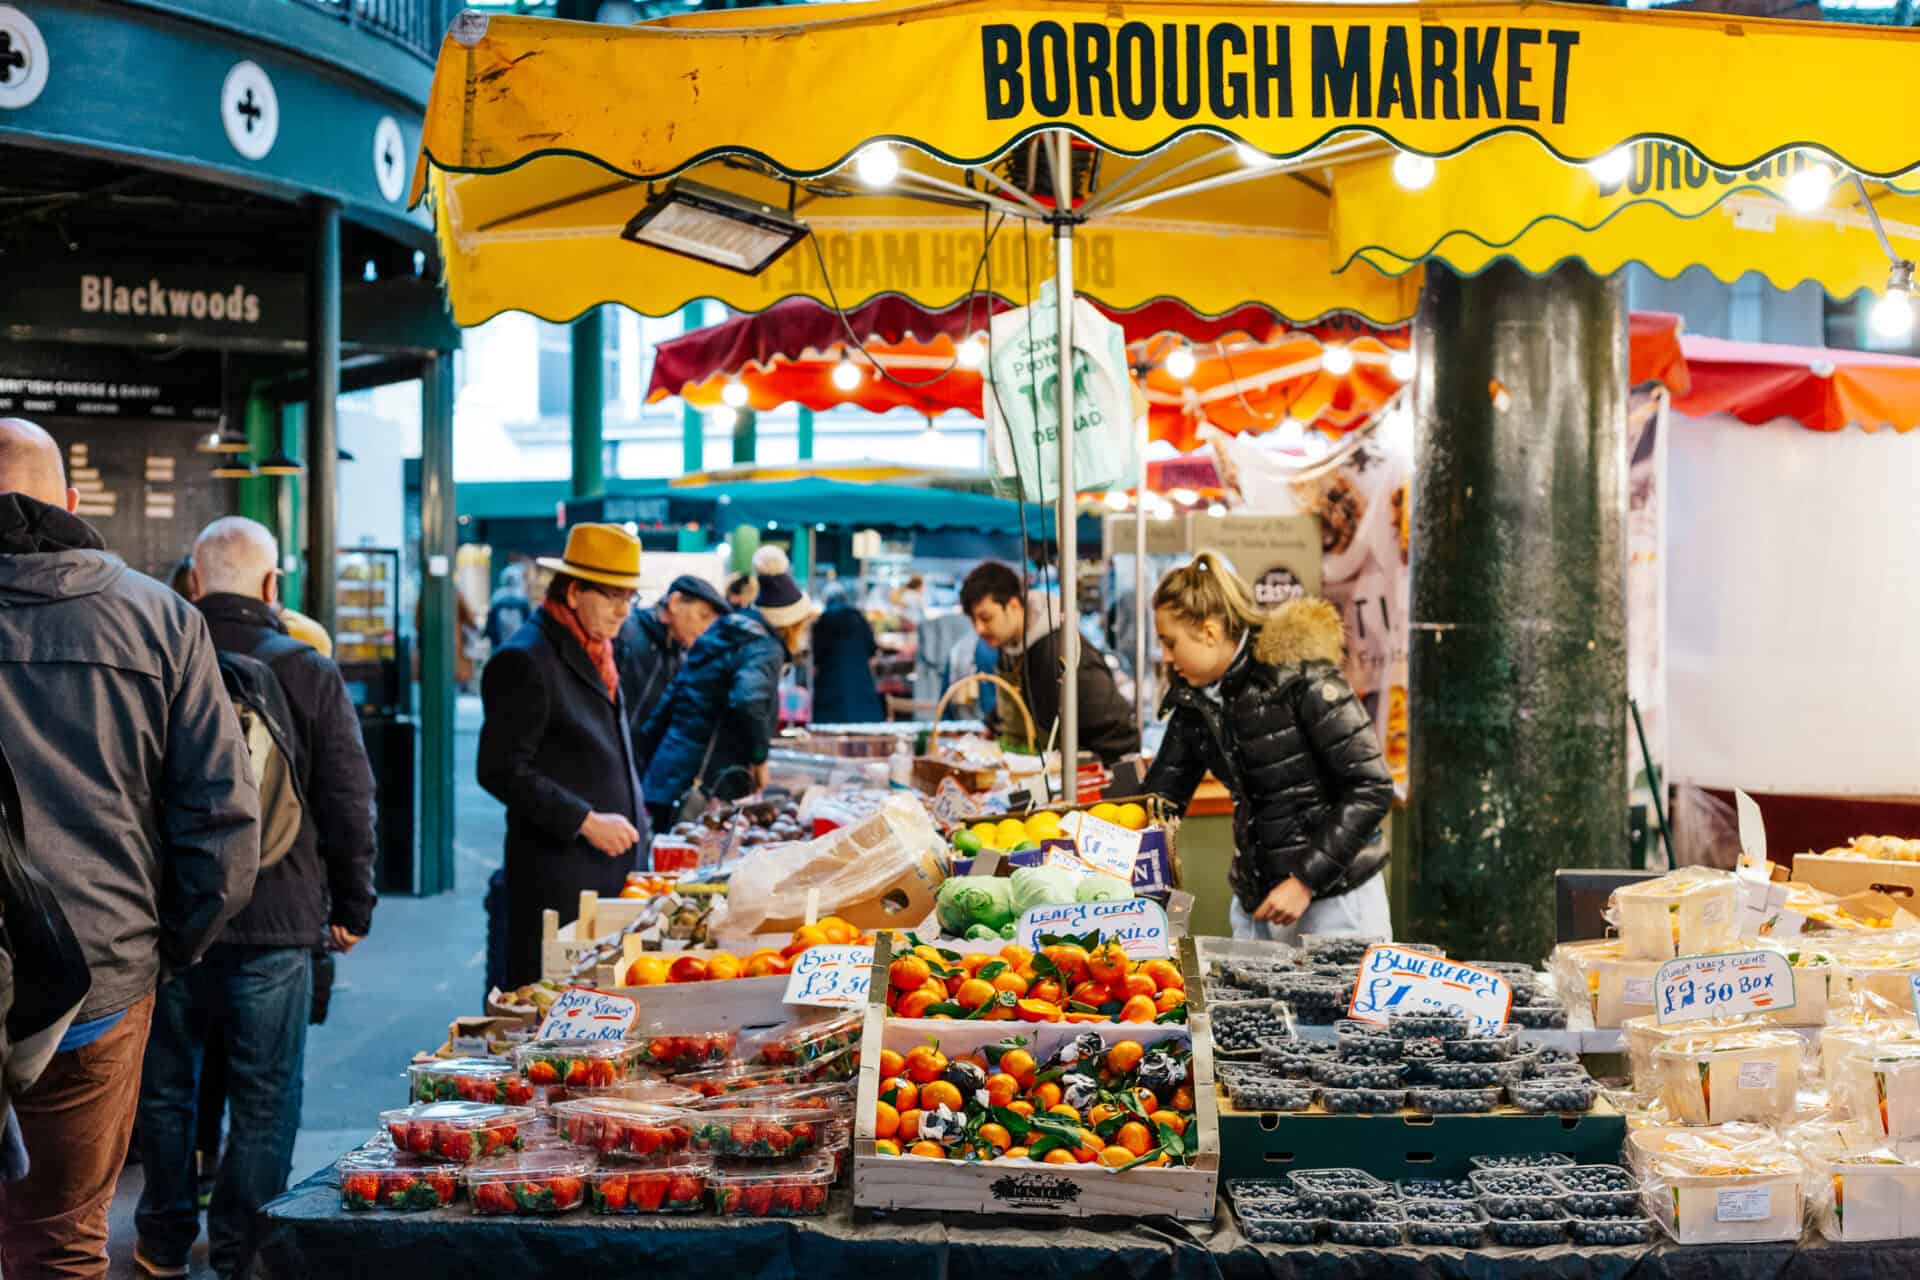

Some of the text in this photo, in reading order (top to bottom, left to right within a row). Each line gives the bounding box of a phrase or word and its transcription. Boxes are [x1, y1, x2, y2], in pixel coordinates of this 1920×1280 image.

[981, 20, 1580, 125] BOROUGH MARKET
[80, 274, 260, 322] Blackwoods
[1115, 926, 1161, 944] KILO
[1370, 949, 1499, 998] BLUEBERRY
